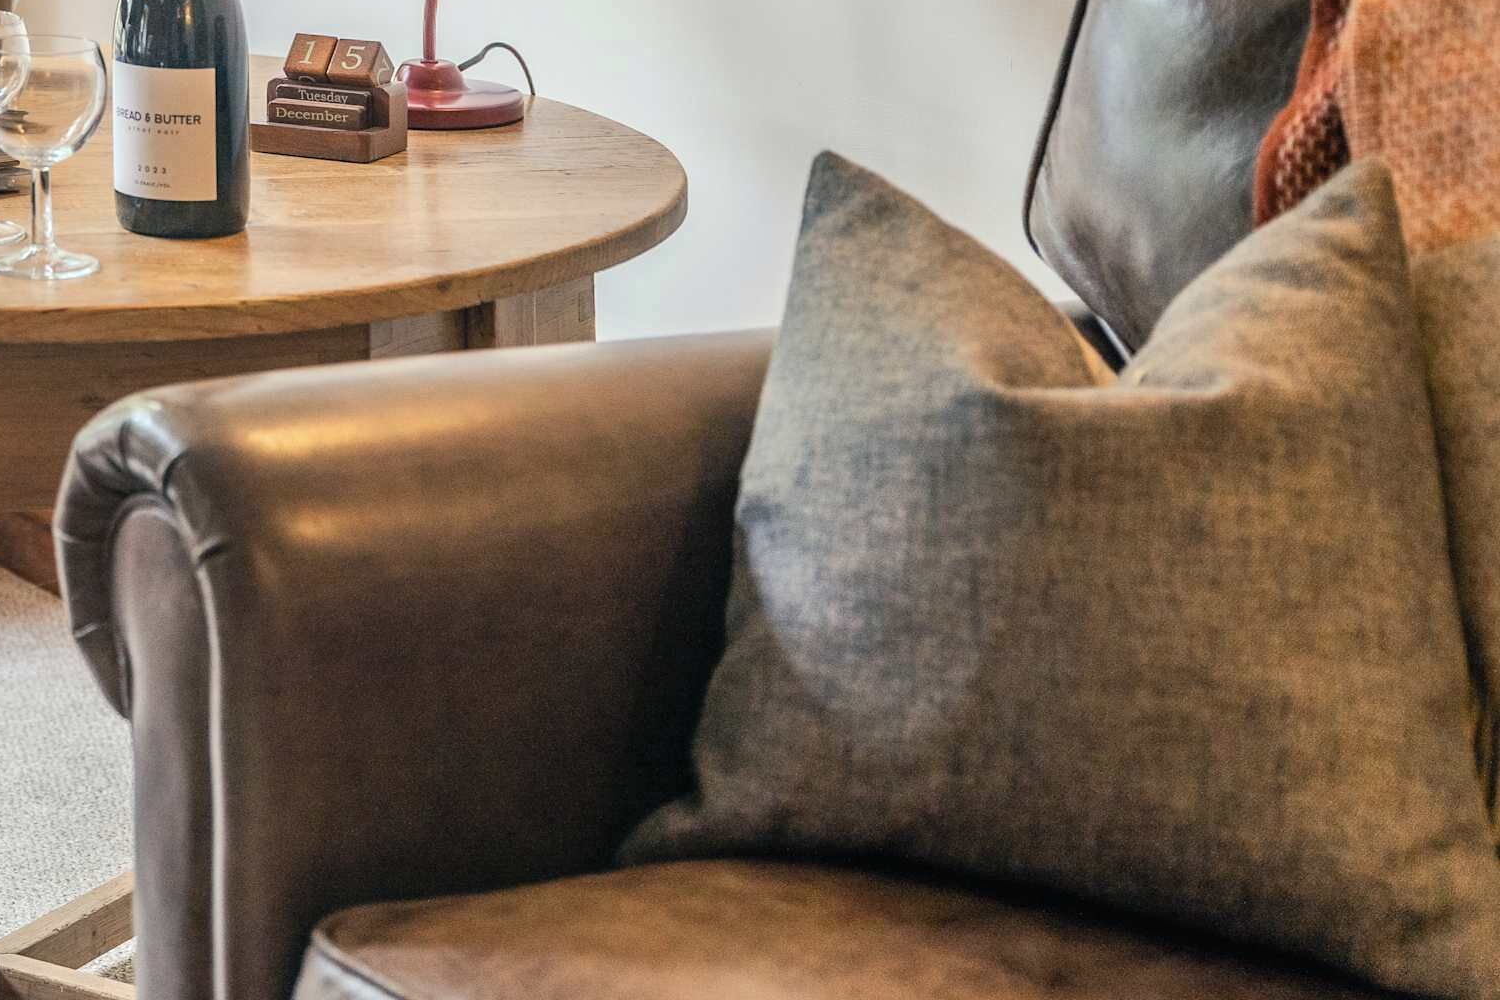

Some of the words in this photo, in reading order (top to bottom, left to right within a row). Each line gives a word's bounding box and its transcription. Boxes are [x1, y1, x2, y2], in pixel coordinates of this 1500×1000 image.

[297, 89, 349, 105] Tuesday
[145, 112, 151, 122] &
[154, 113, 202, 125] BUTTER
[275, 107, 349, 122] December
[137, 164, 168, 175] 2023
